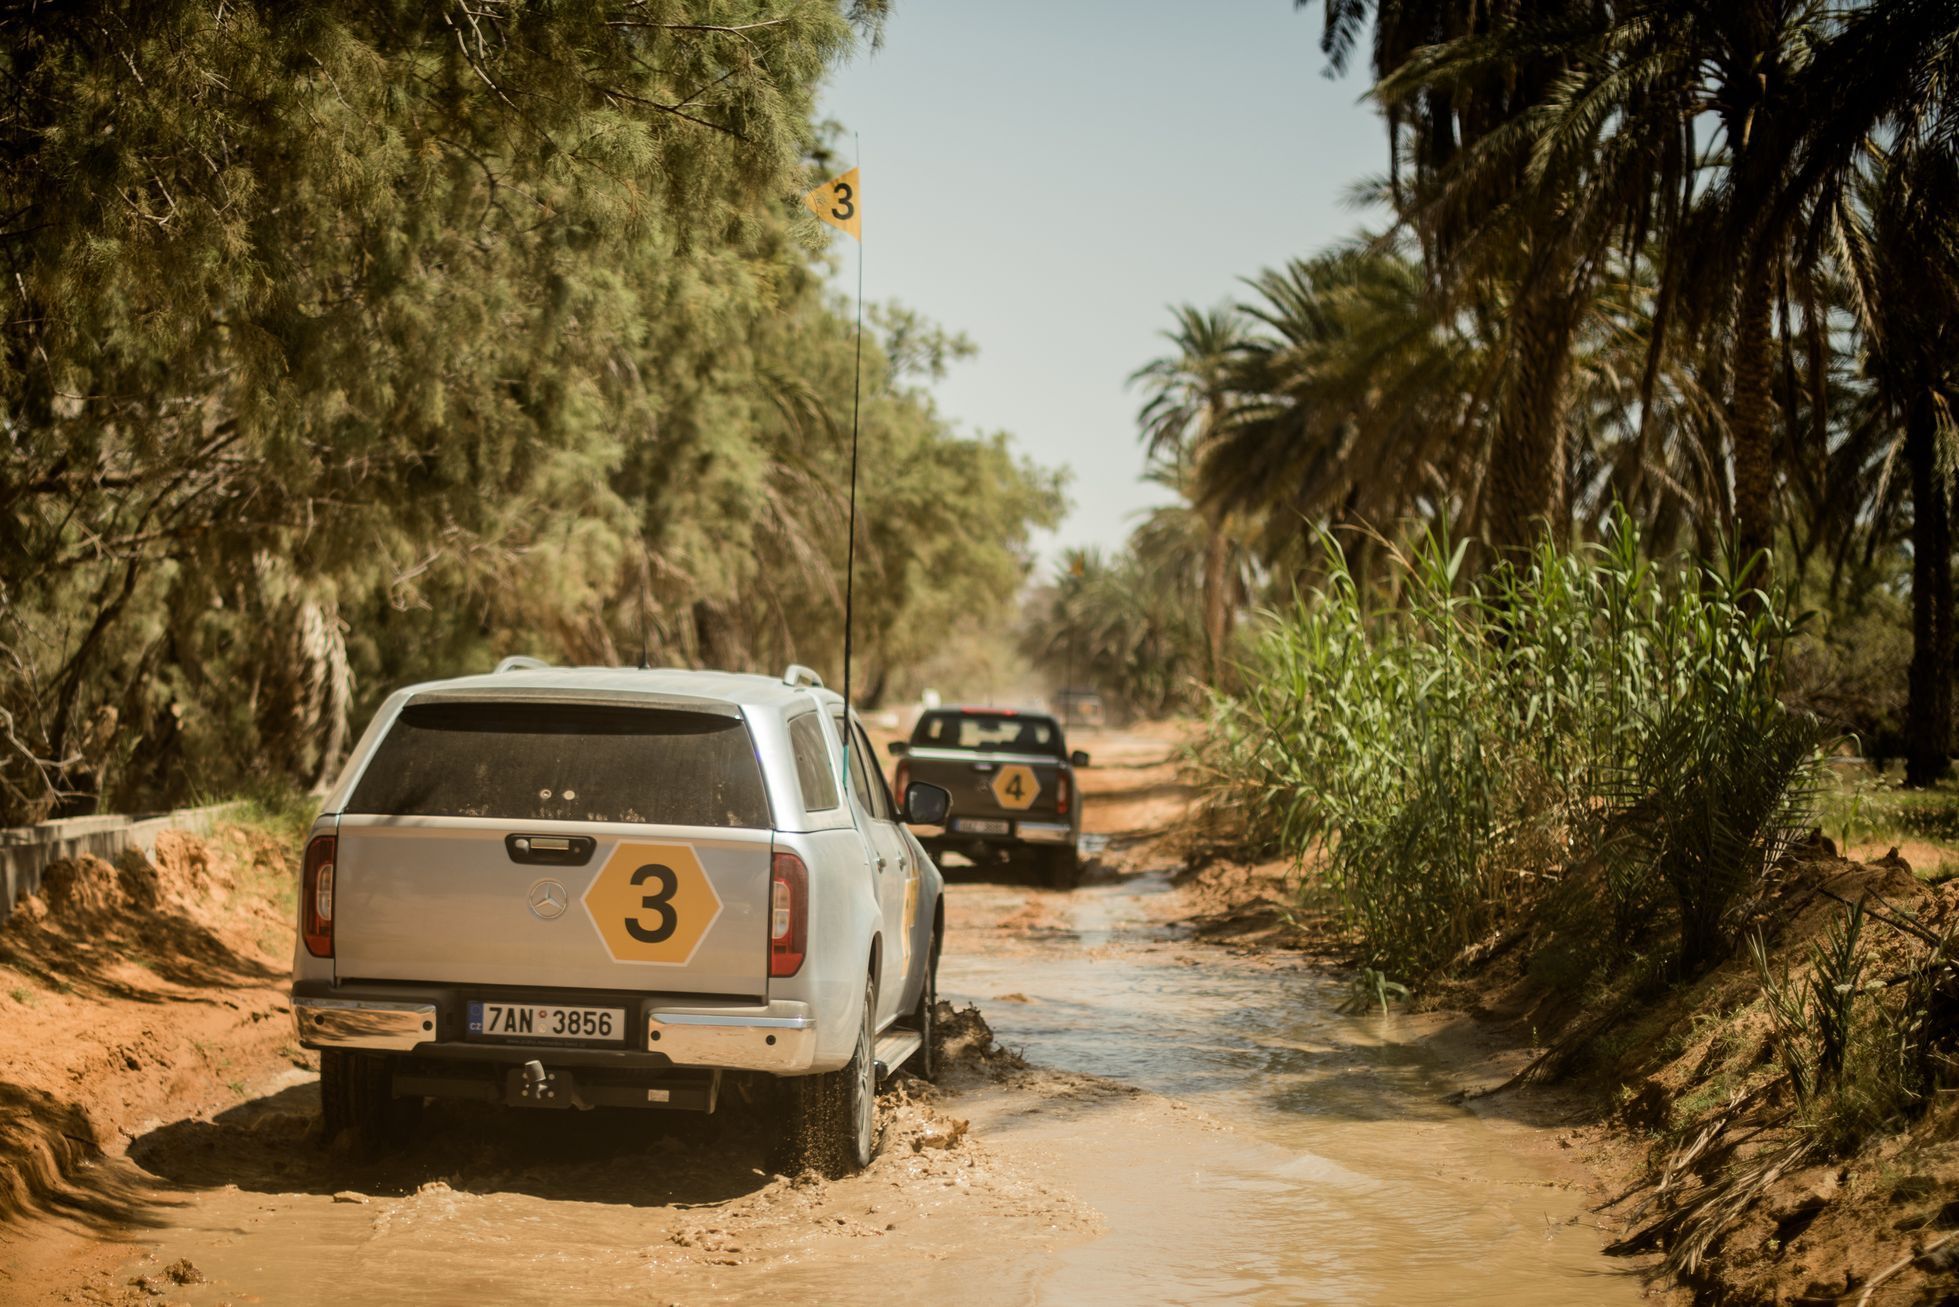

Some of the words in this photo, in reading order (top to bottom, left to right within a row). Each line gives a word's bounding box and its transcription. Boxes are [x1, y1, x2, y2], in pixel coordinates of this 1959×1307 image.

[831, 182, 854, 220] 3
[1005, 773, 1026, 801] 4
[624, 863, 678, 944] 3
[469, 1022, 482, 1031] CZ
[488, 1007, 534, 1033] 7AN
[552, 1010, 612, 1036] 3856
